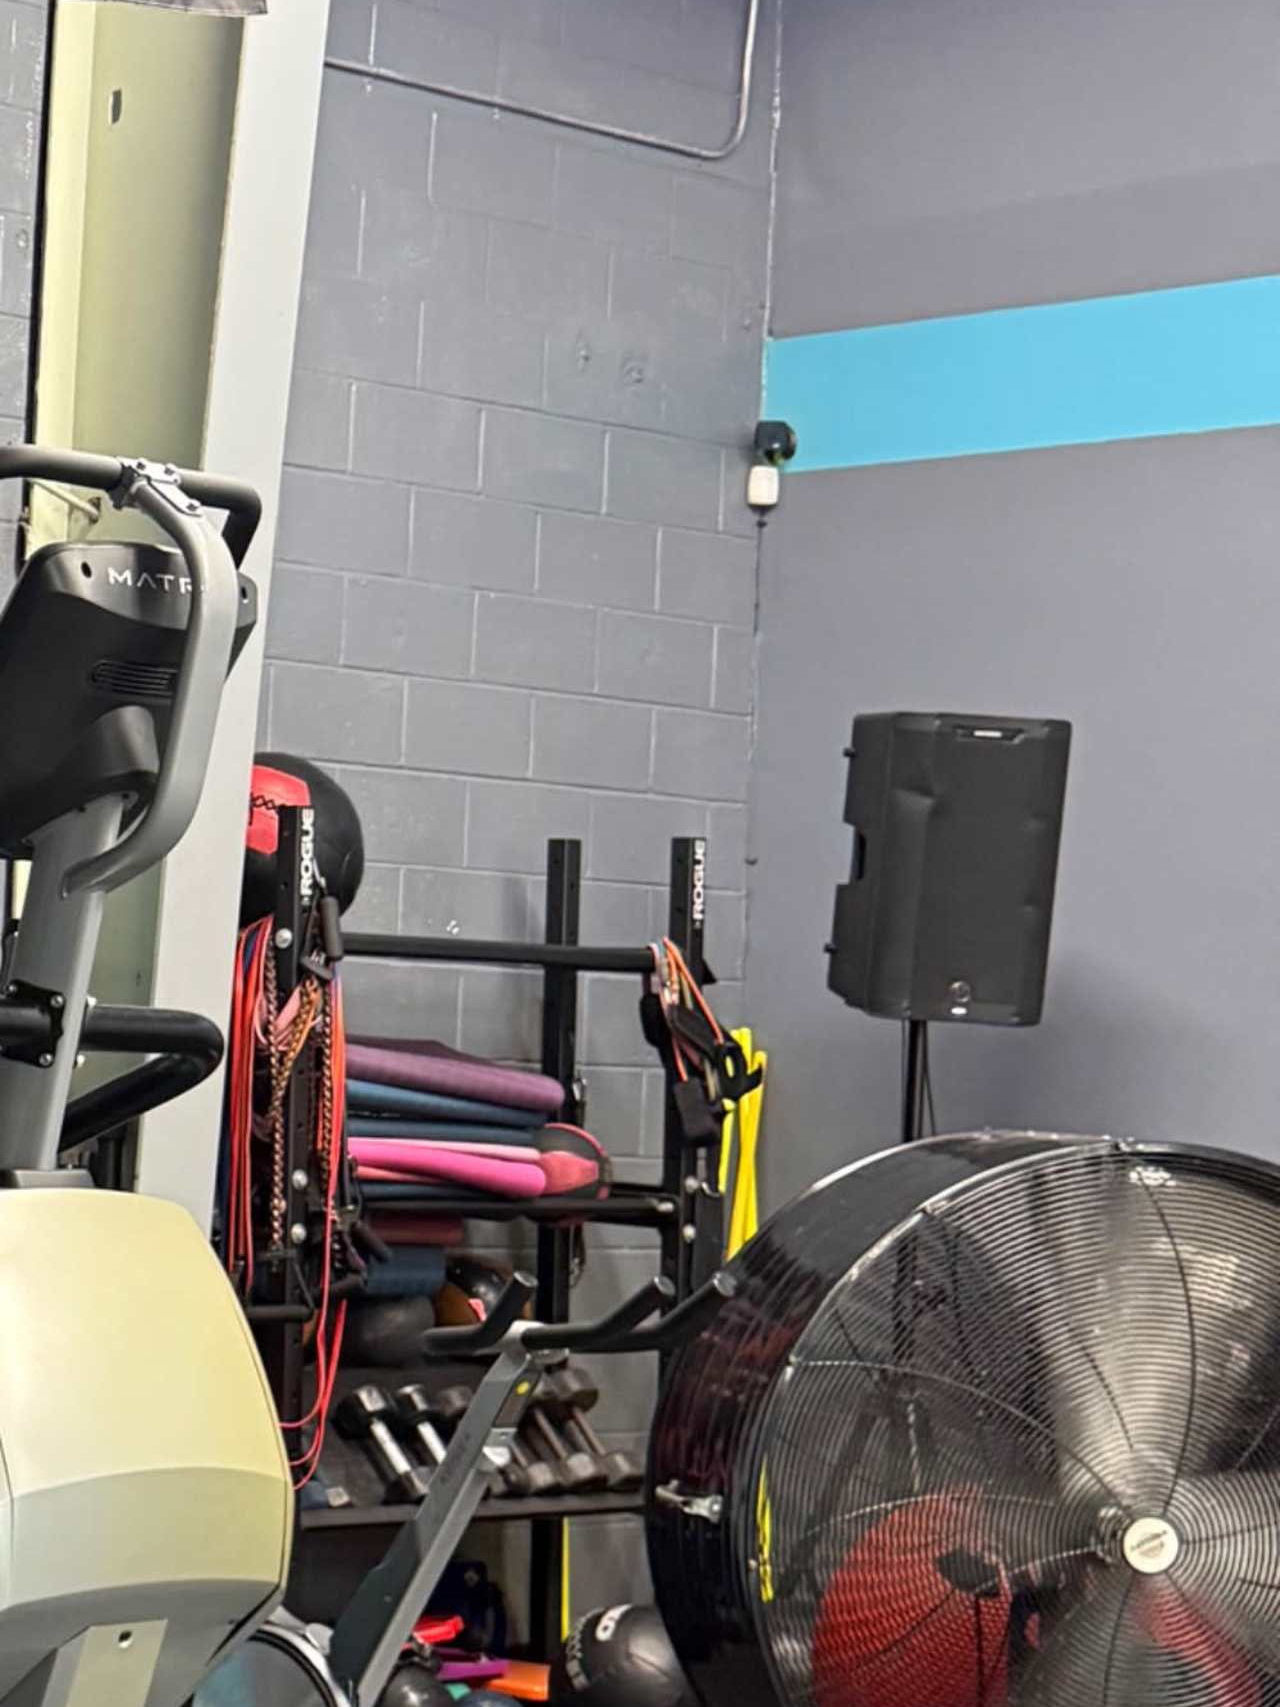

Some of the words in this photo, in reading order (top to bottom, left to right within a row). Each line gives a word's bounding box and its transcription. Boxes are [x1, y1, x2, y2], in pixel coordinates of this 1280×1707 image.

[107, 566, 193, 594] MATR
[301, 808, 315, 896] ROGUE
[692, 839, 705, 920] ROGUE
